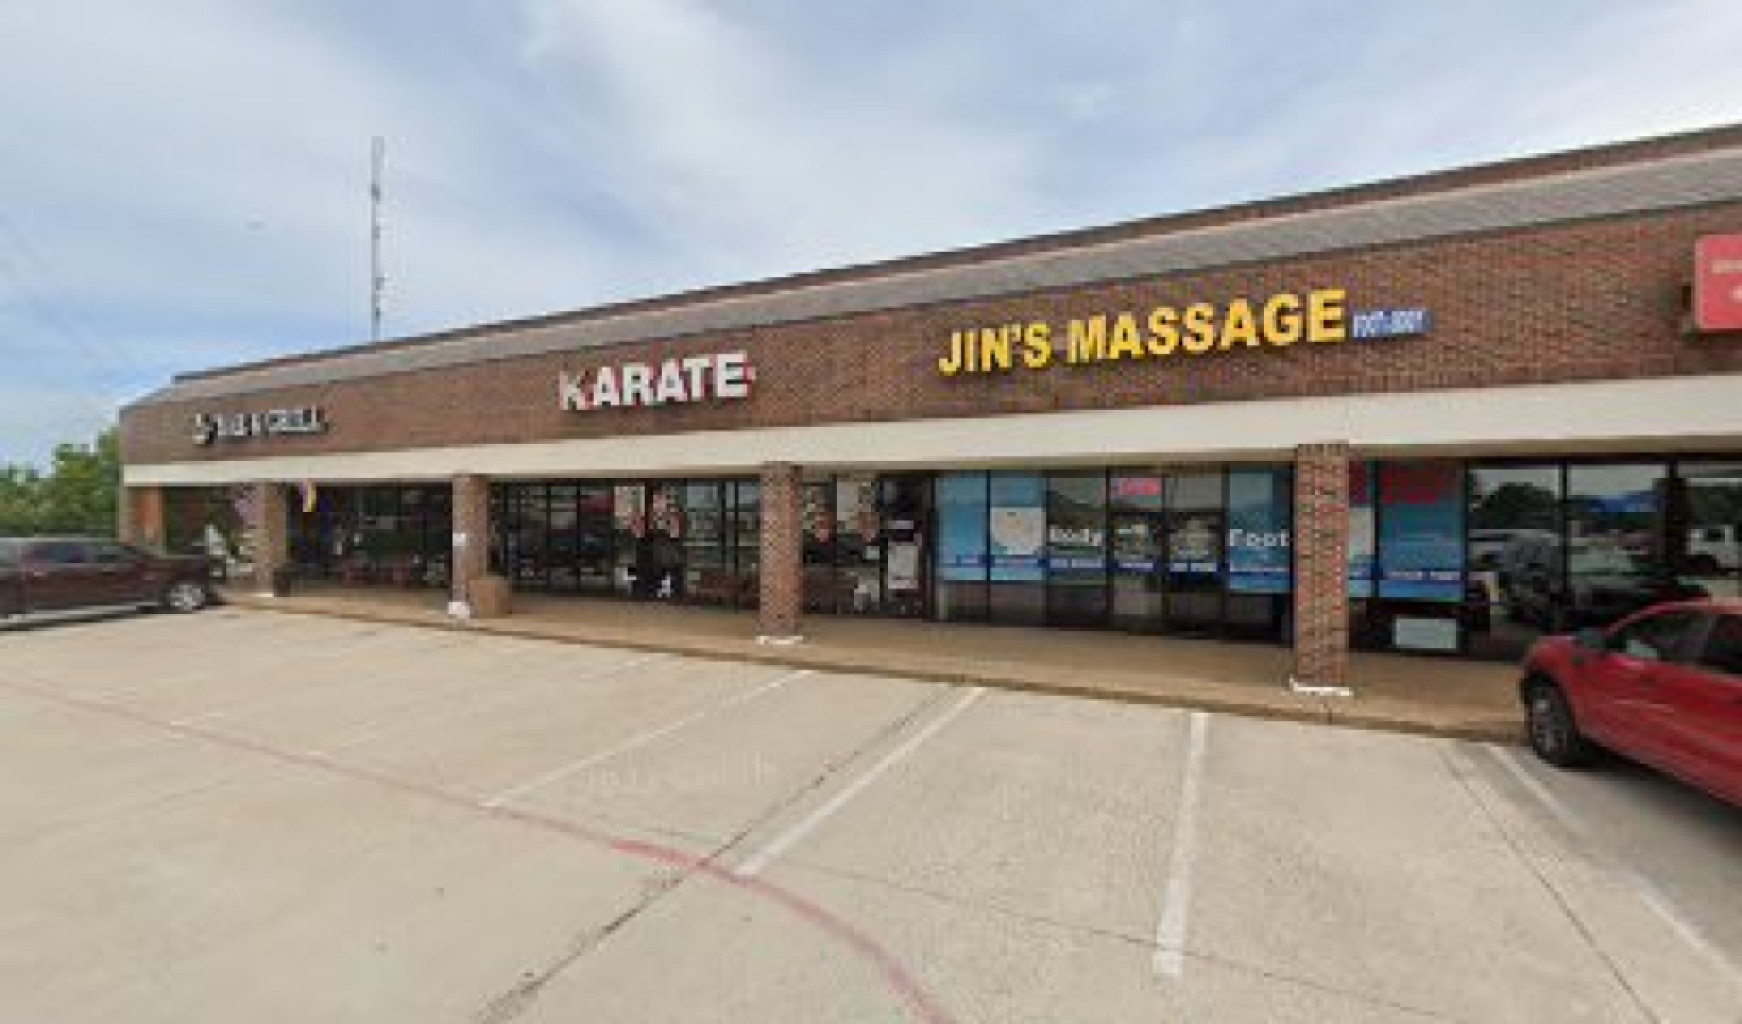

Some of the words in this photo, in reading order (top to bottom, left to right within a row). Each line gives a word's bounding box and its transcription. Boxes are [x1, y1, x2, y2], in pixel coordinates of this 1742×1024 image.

[938, 322, 1051, 376] JIN'S
[1066, 289, 1346, 365] MASSAGE
[558, 352, 752, 411] KARATE
[1048, 526, 1103, 547] Body
[1229, 528, 1290, 547] Foot
